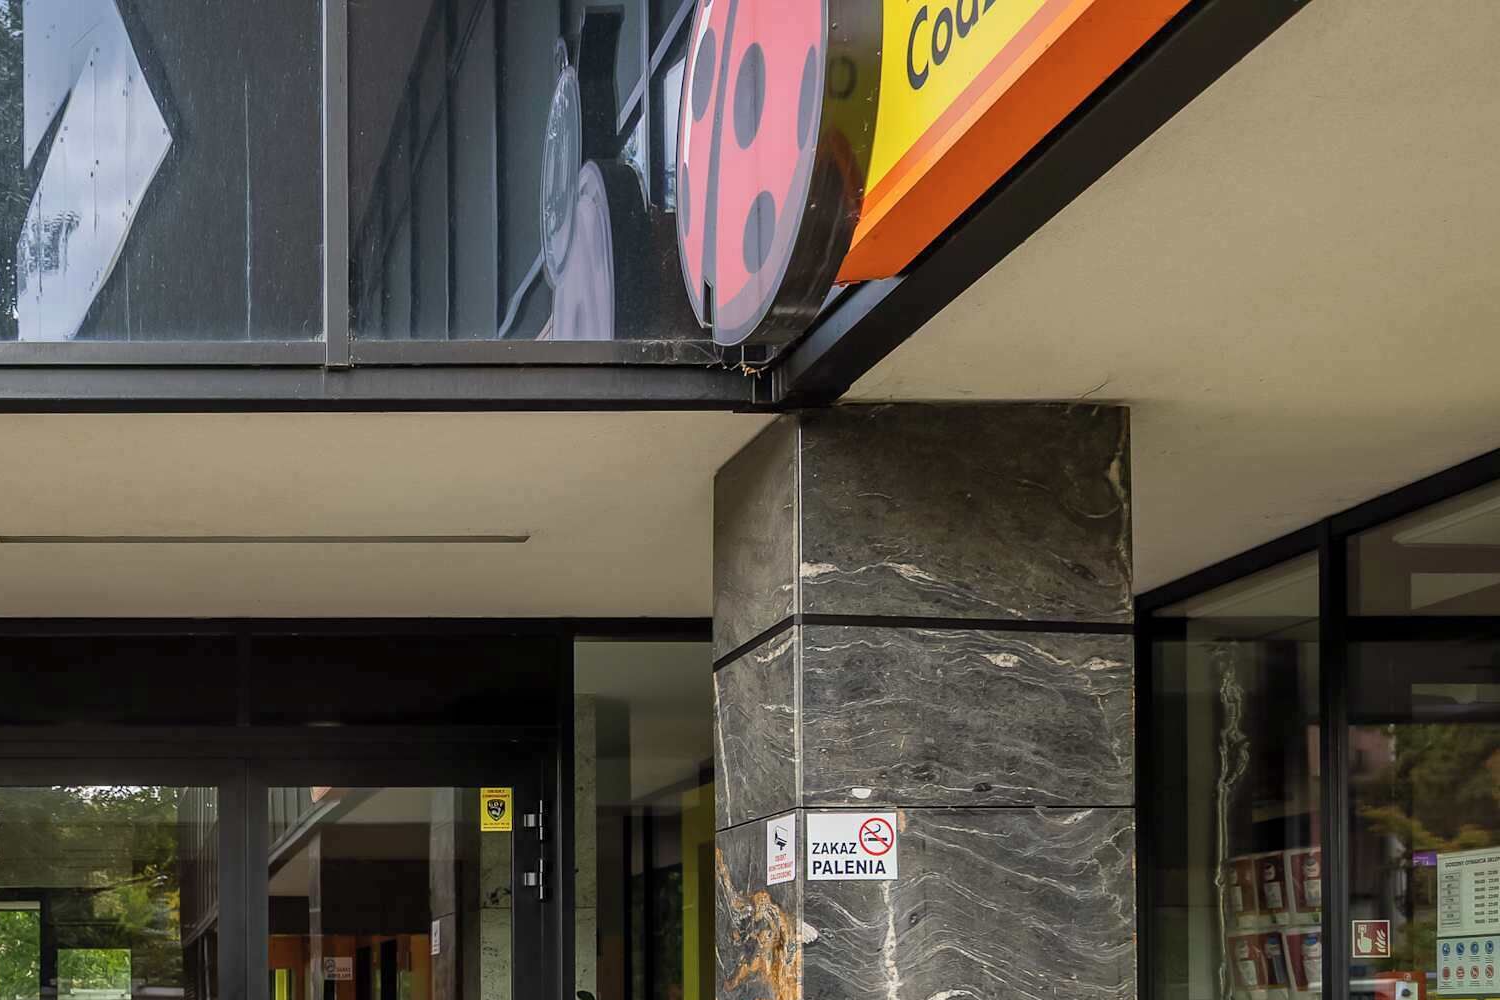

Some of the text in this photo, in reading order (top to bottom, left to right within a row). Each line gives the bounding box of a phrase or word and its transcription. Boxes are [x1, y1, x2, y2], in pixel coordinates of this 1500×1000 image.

[907, 0, 996, 90] Co
[812, 842, 857, 855] ZAKAZ
[812, 860, 886, 875] PALENIA
